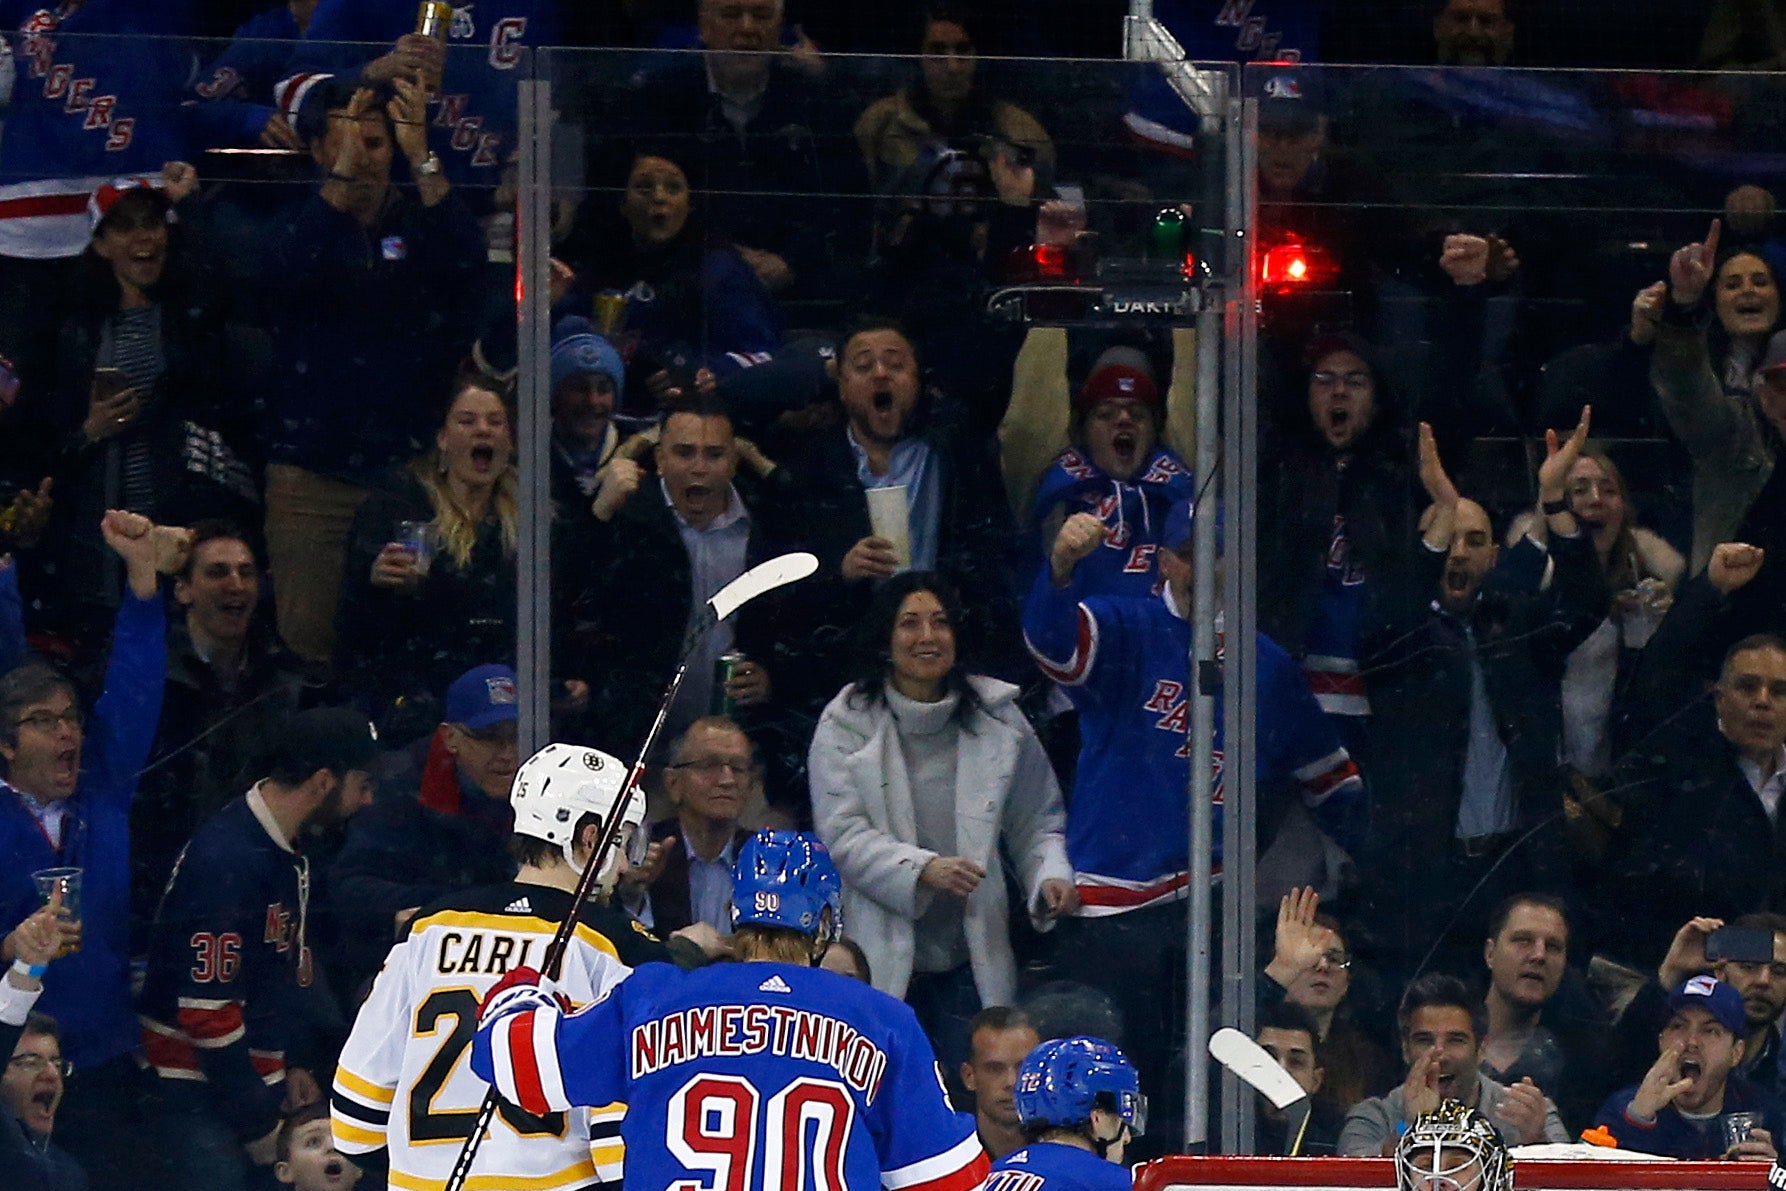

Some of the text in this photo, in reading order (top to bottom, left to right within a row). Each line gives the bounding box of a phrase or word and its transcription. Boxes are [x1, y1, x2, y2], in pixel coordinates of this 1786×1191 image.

[754, 891, 780, 912] 90
[190, 932, 244, 984] 36
[438, 932, 566, 979] CARL
